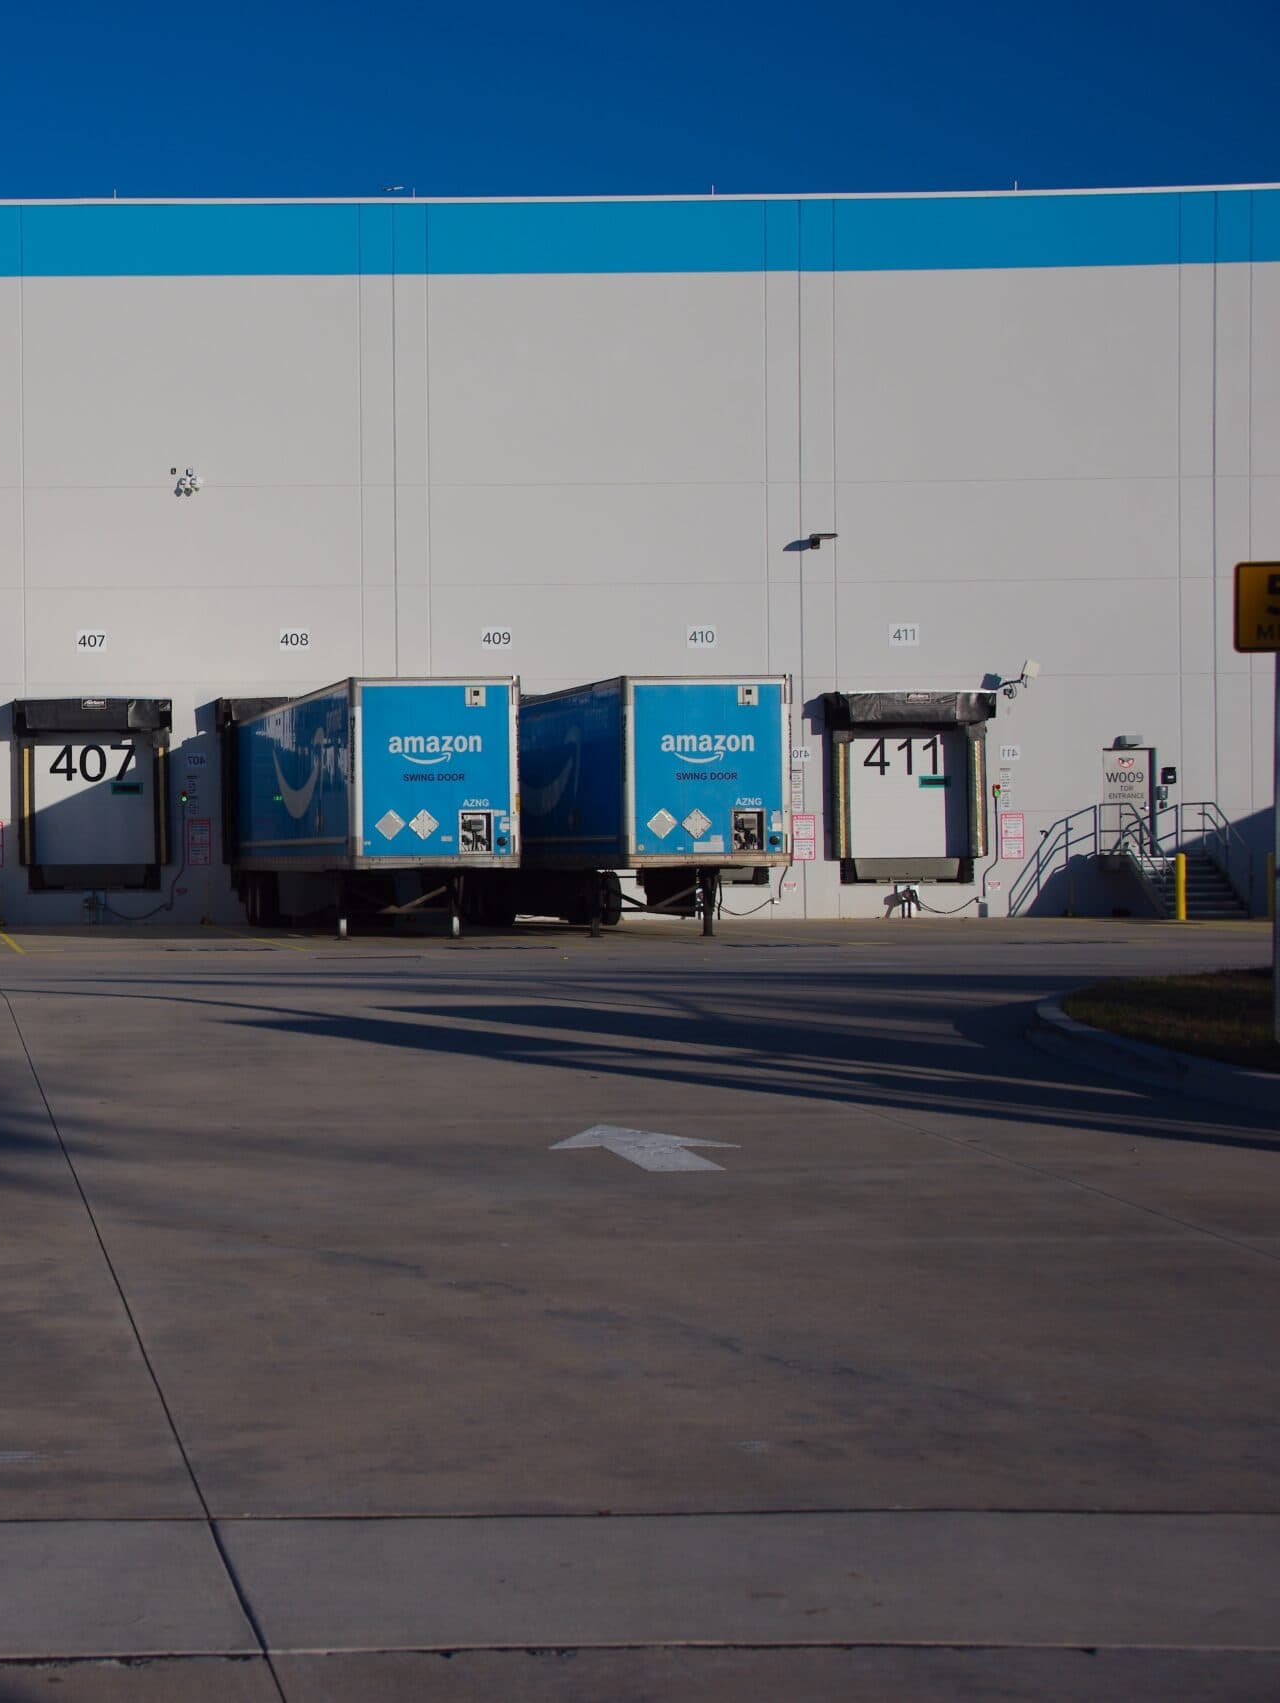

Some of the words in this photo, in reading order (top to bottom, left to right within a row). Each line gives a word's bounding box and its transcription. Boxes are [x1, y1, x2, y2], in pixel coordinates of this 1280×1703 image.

[78, 634, 105, 648] 407
[280, 633, 309, 646] 408
[482, 631, 511, 645] 409
[688, 630, 715, 644] 410
[892, 628, 915, 641] 411
[388, 734, 481, 756] amazon
[660, 733, 754, 755] amazon
[863, 736, 939, 776] 411
[49, 744, 136, 782] 407
[403, 773, 435, 782] SWING
[437, 773, 465, 782] DOOR
[675, 772, 708, 781] SWING
[709, 772, 738, 781] DOOR
[1106, 772, 1143, 782] W009
[462, 798, 490, 808] AZNG
[735, 797, 762, 806] AZNG
